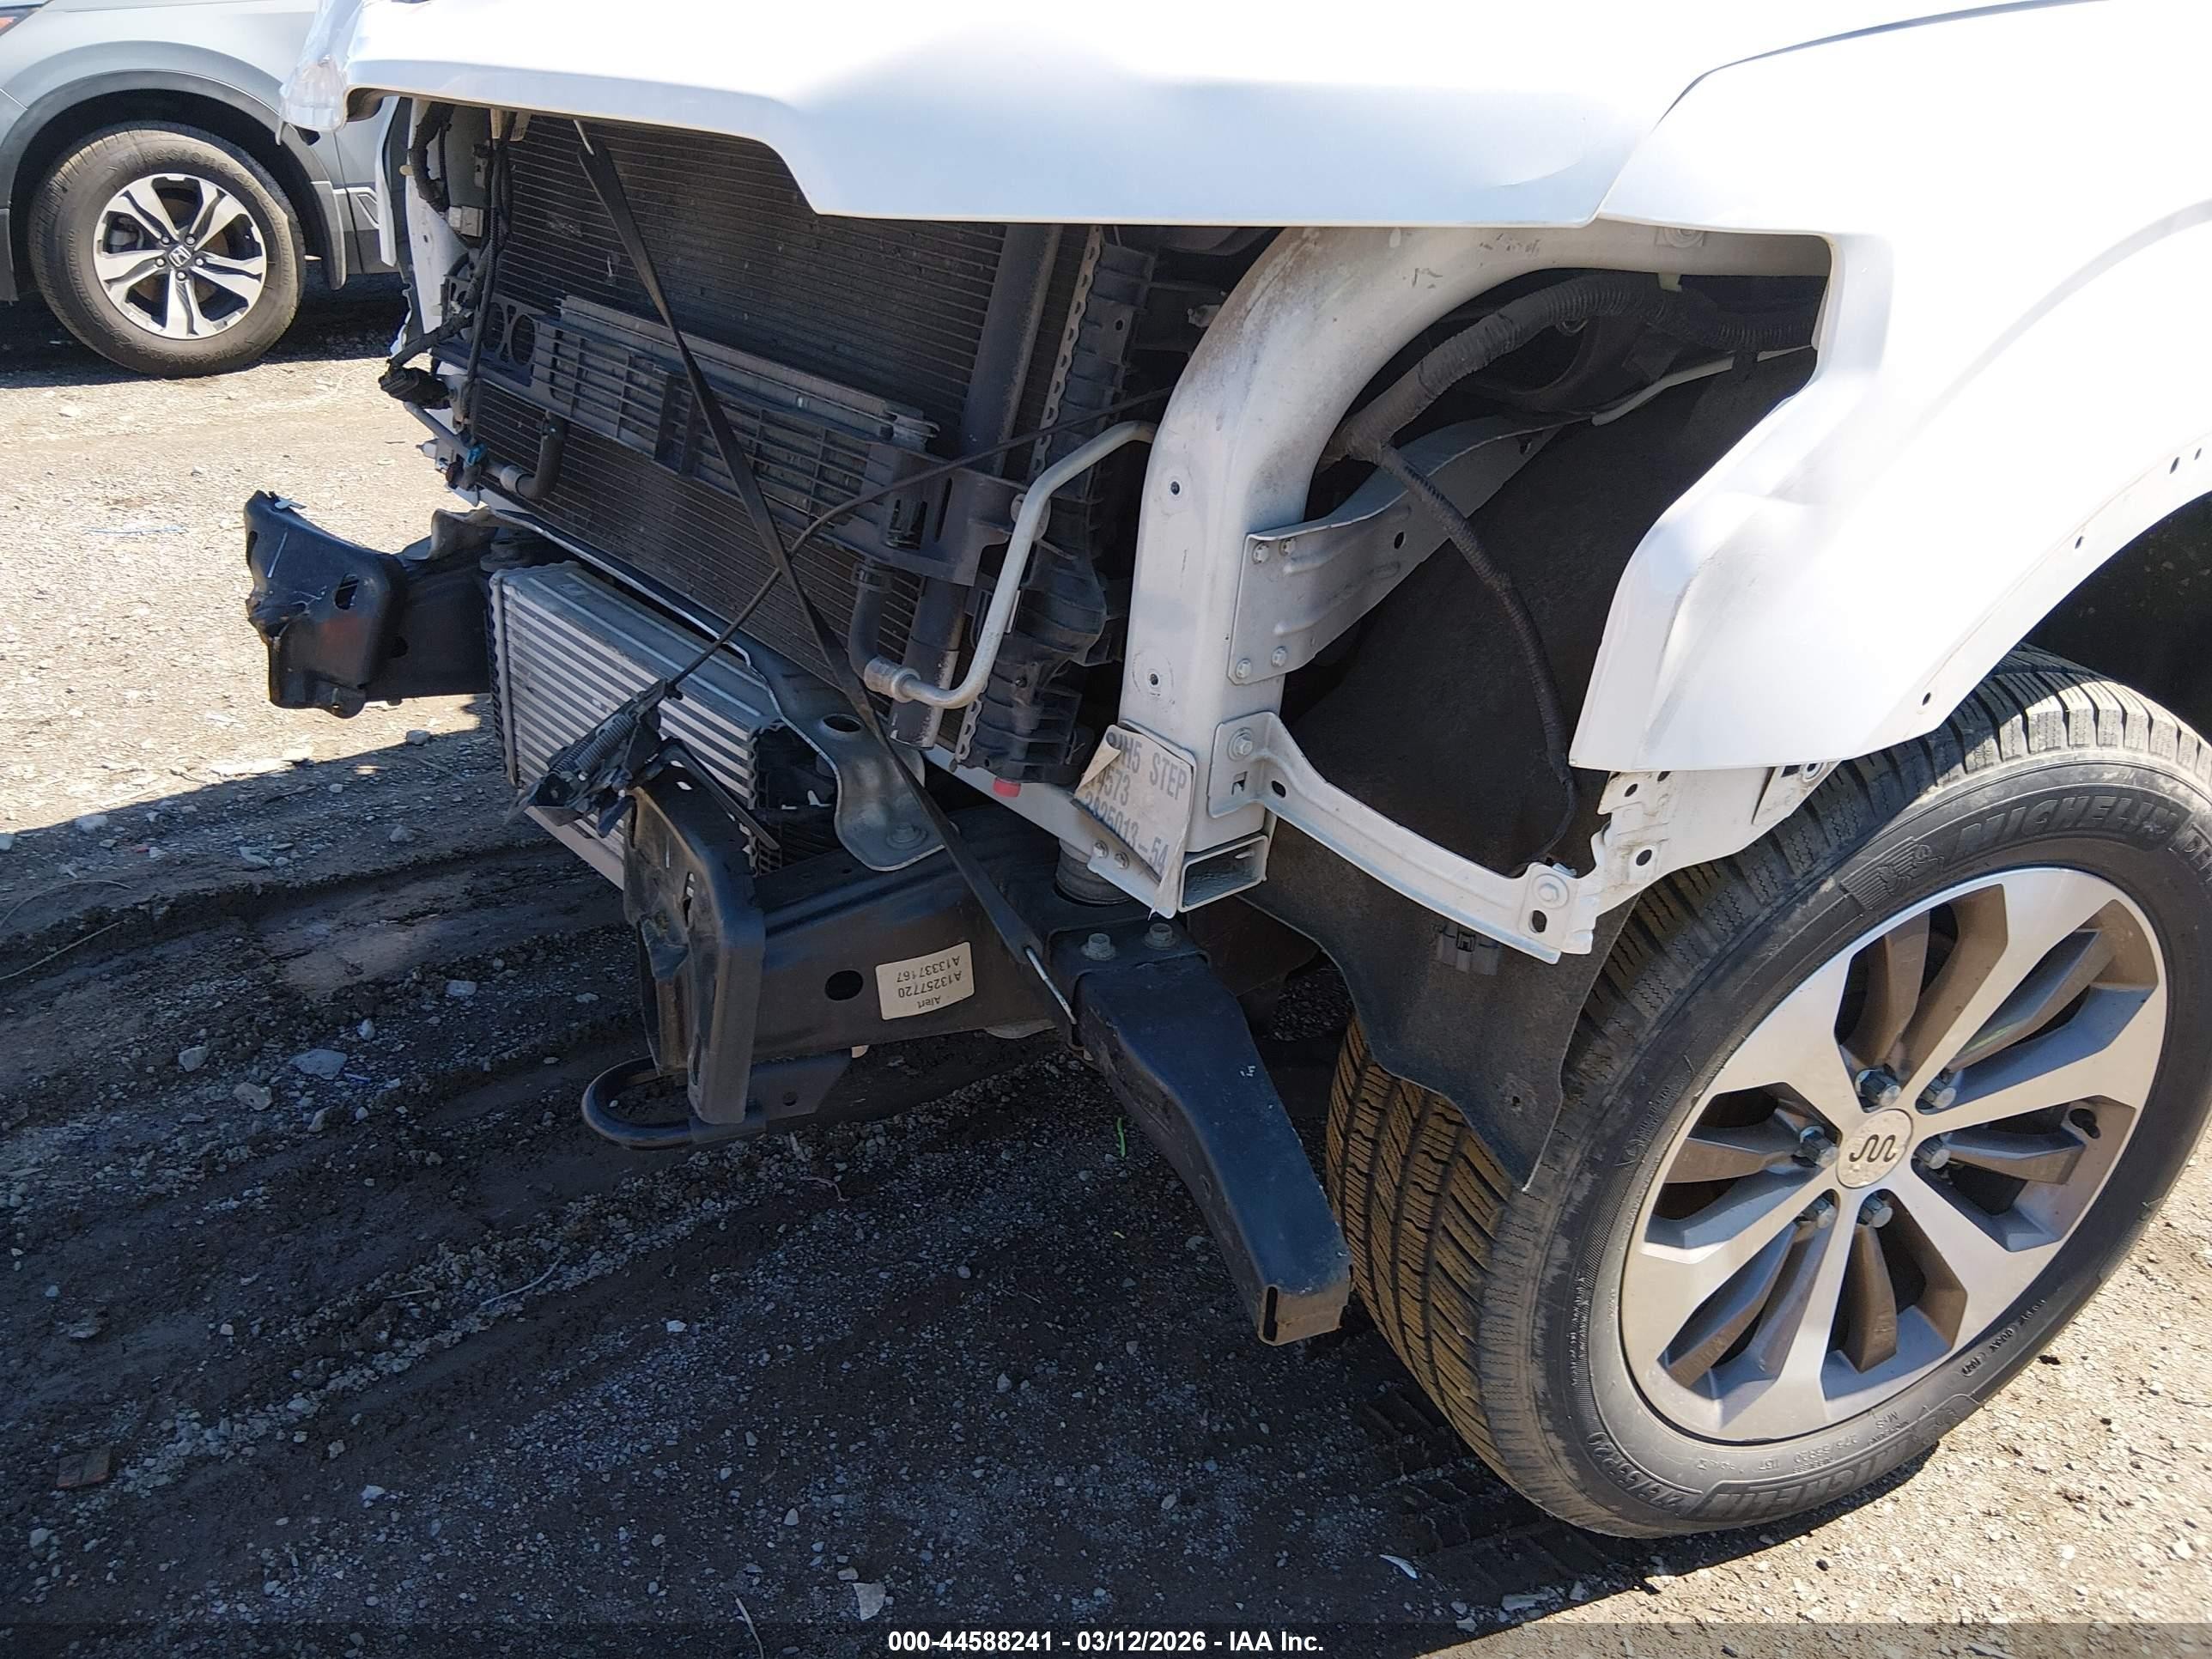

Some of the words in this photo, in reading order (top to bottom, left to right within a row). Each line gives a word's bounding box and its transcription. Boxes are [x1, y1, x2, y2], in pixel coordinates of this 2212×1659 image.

[1150, 752, 1188, 800] STEP
[1951, 796, 2179, 861] MICHELIN
[898, 970, 963, 998] A13257720
[917, 995, 942, 1009] Alert
